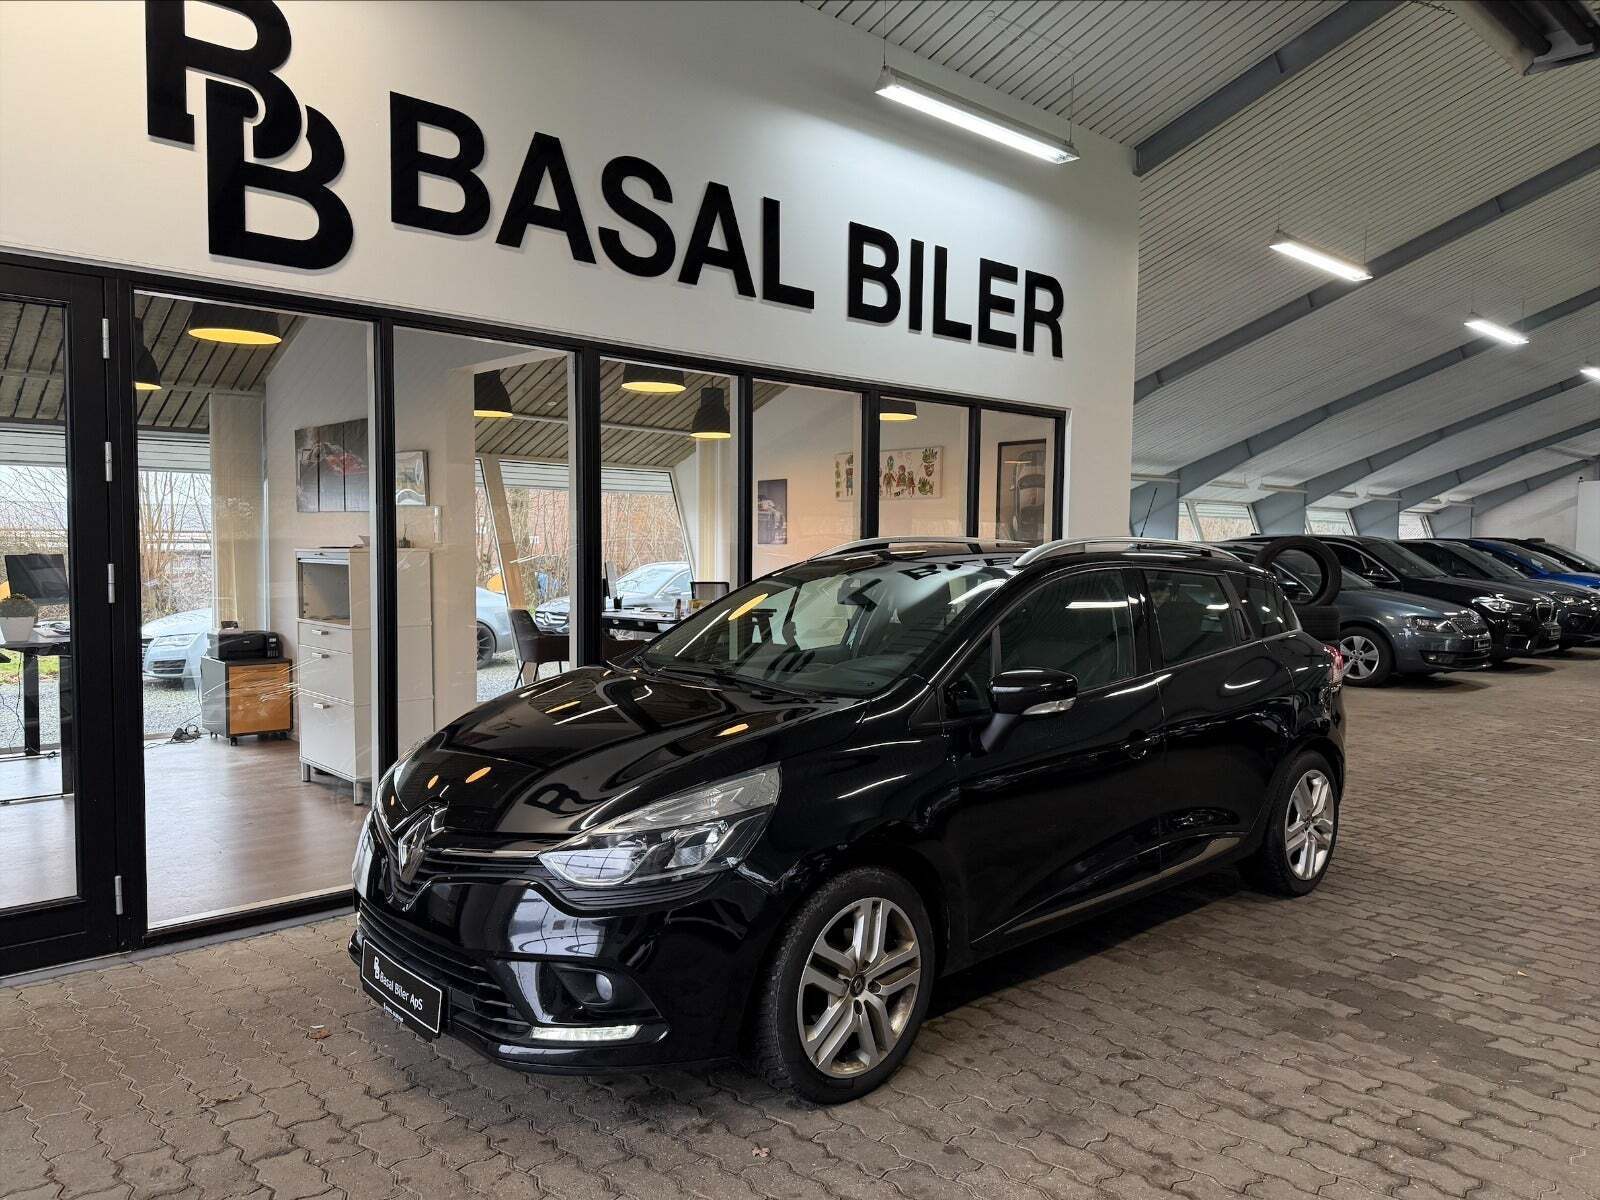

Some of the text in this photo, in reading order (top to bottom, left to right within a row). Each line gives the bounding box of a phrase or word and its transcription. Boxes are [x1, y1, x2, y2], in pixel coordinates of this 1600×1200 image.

[390, 91, 1064, 359] BASAL BILER
[380, 970, 423, 1011] Basal Biler ApS
